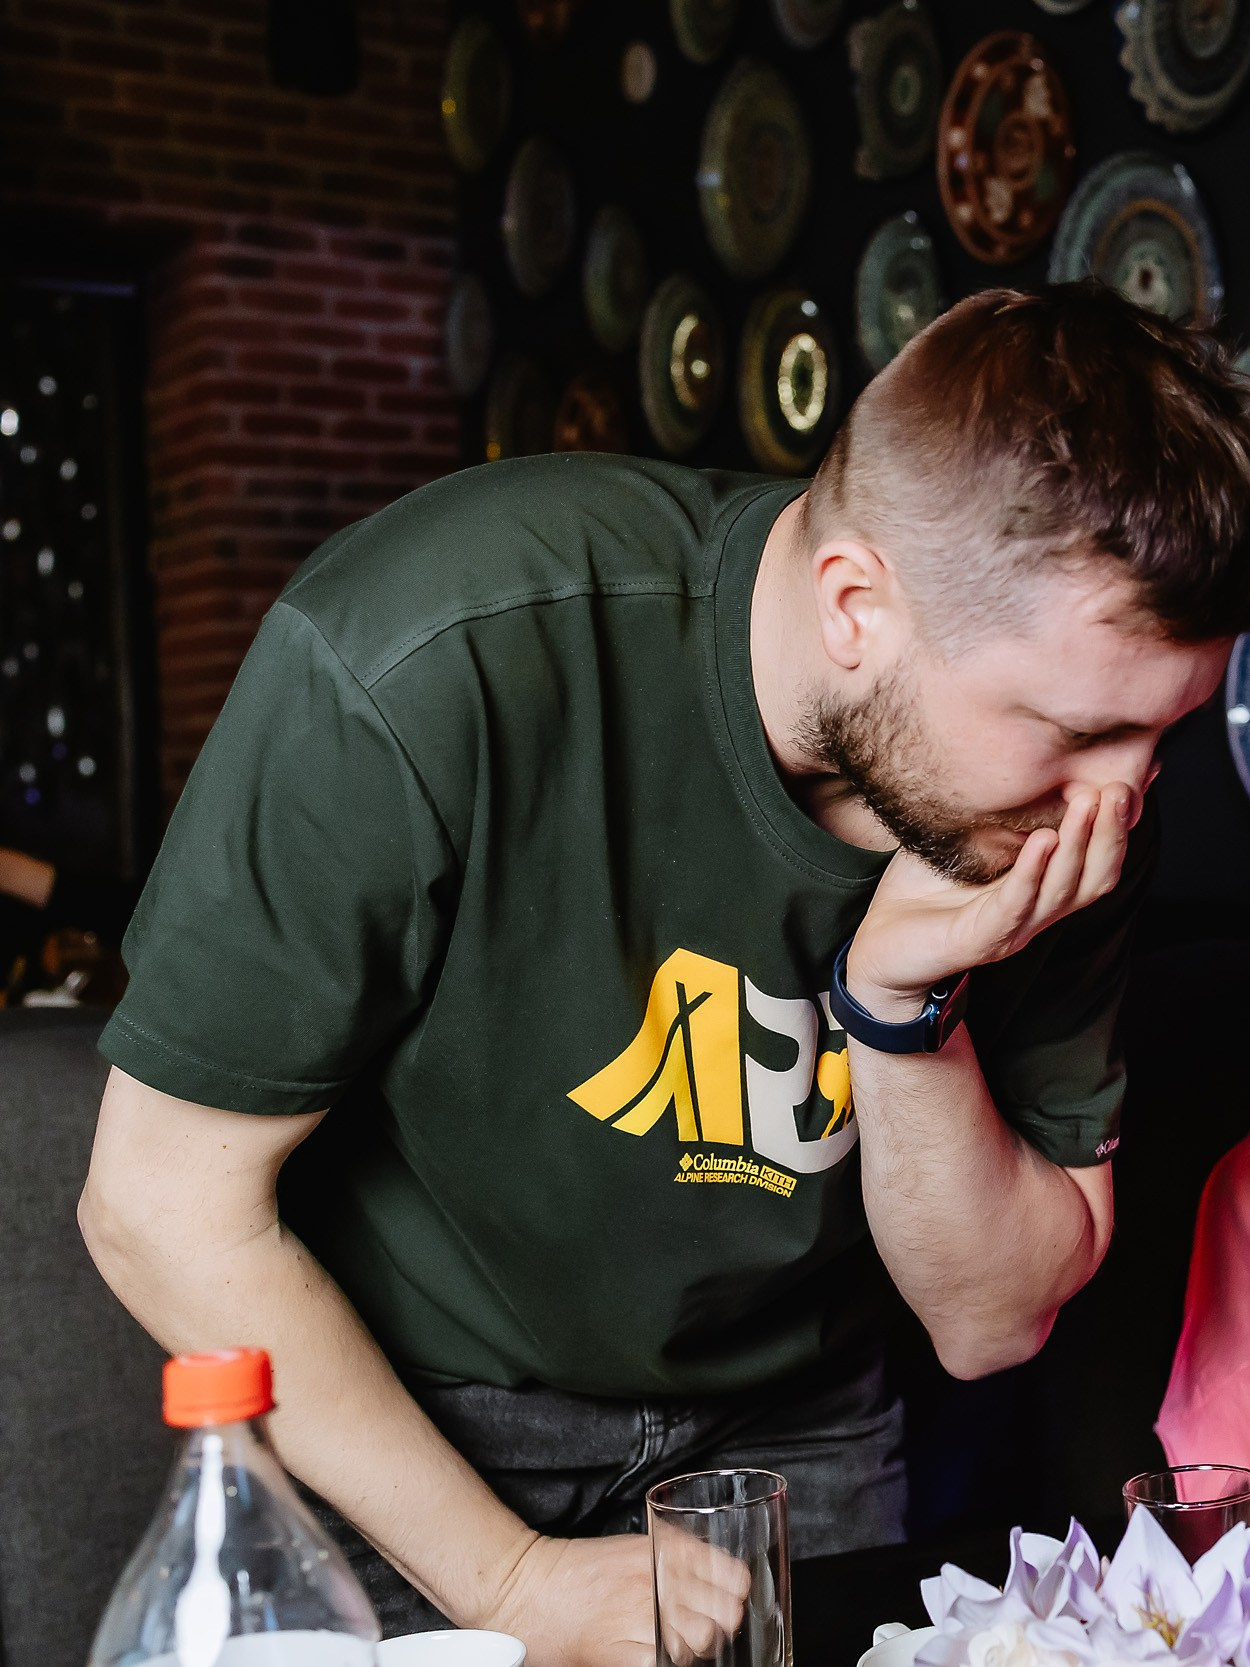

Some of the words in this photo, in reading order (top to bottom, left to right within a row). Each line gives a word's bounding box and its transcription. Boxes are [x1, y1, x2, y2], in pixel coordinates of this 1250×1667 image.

[674, 1172, 704, 1183] ALPINE
[704, 1172, 748, 1184] RESEARCH
[748, 1175, 792, 1198] DIVISION
[693, 1153, 760, 1176] Columbia
[761, 1166, 797, 1190] KITH
